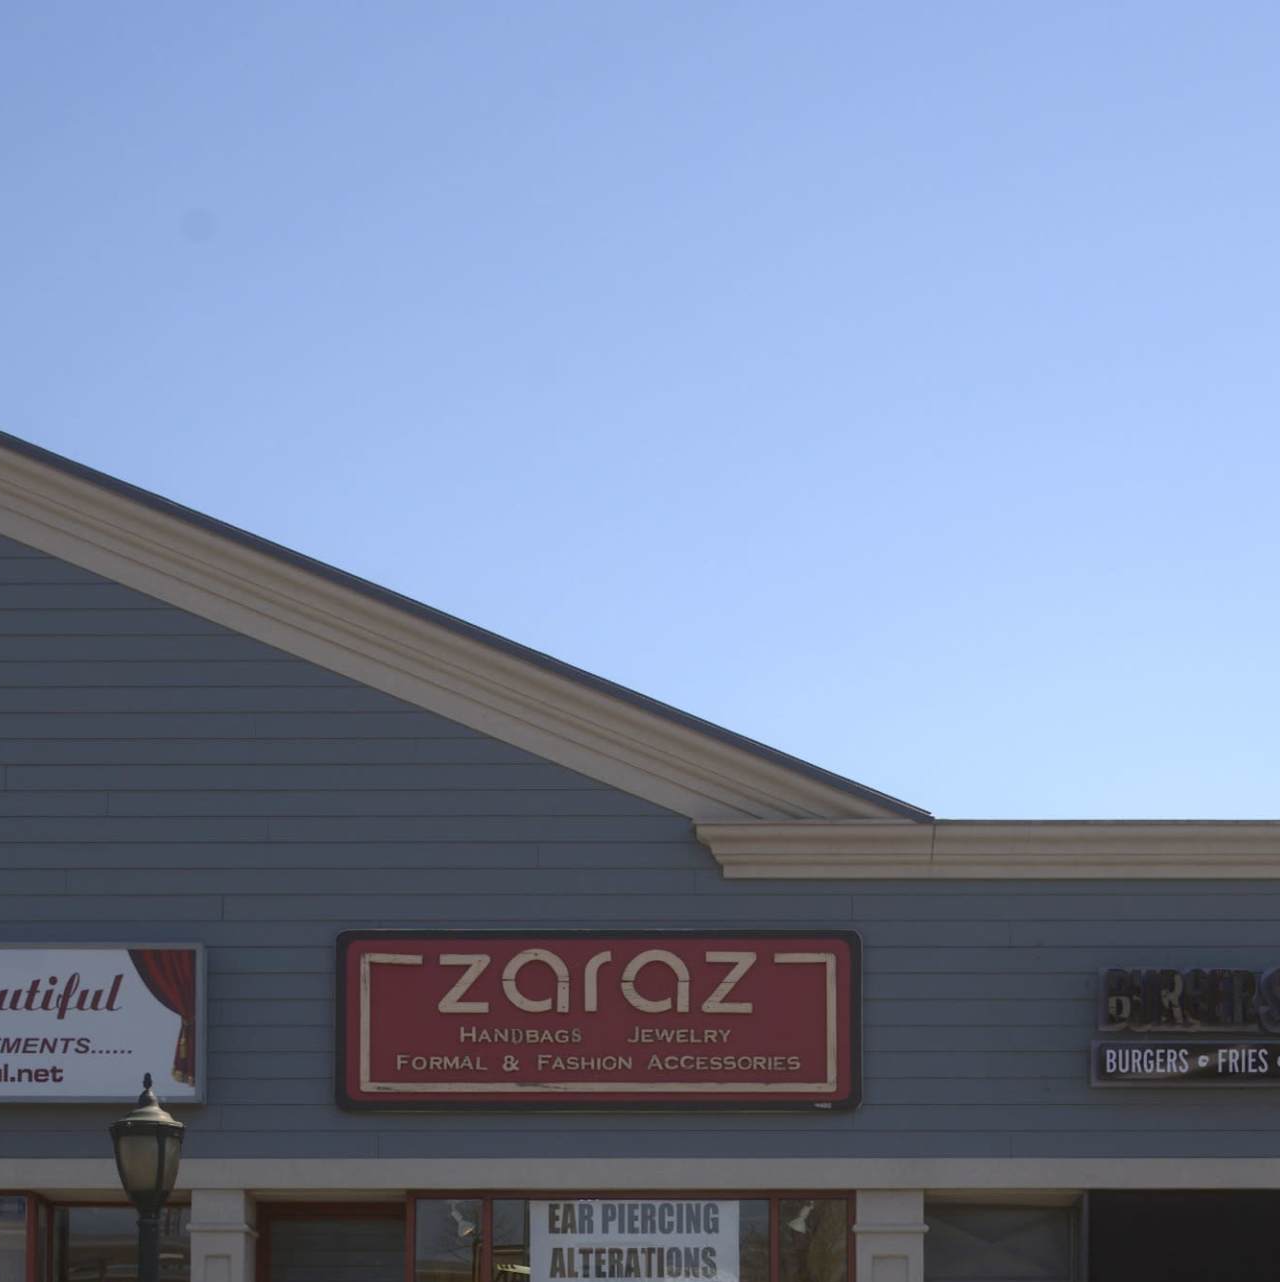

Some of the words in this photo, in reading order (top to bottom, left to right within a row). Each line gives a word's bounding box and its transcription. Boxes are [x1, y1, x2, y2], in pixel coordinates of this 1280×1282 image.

[438, 948, 757, 1014] zaraz
[627, 1025, 732, 1044] JEWELRY
[396, 1054, 488, 1072] FORMAL
[502, 1054, 520, 1072] &
[537, 1054, 634, 1072] FASHION
[646, 1054, 802, 1072] ACCESSORIES
[1105, 1049, 1189, 1074] BURGERS
[1217, 1049, 1269, 1074] FRIES
[548, 1203, 593, 1235] EAR
[601, 1203, 720, 1235] PIERCING
[549, 1247, 718, 1279] ALTERATIONS
